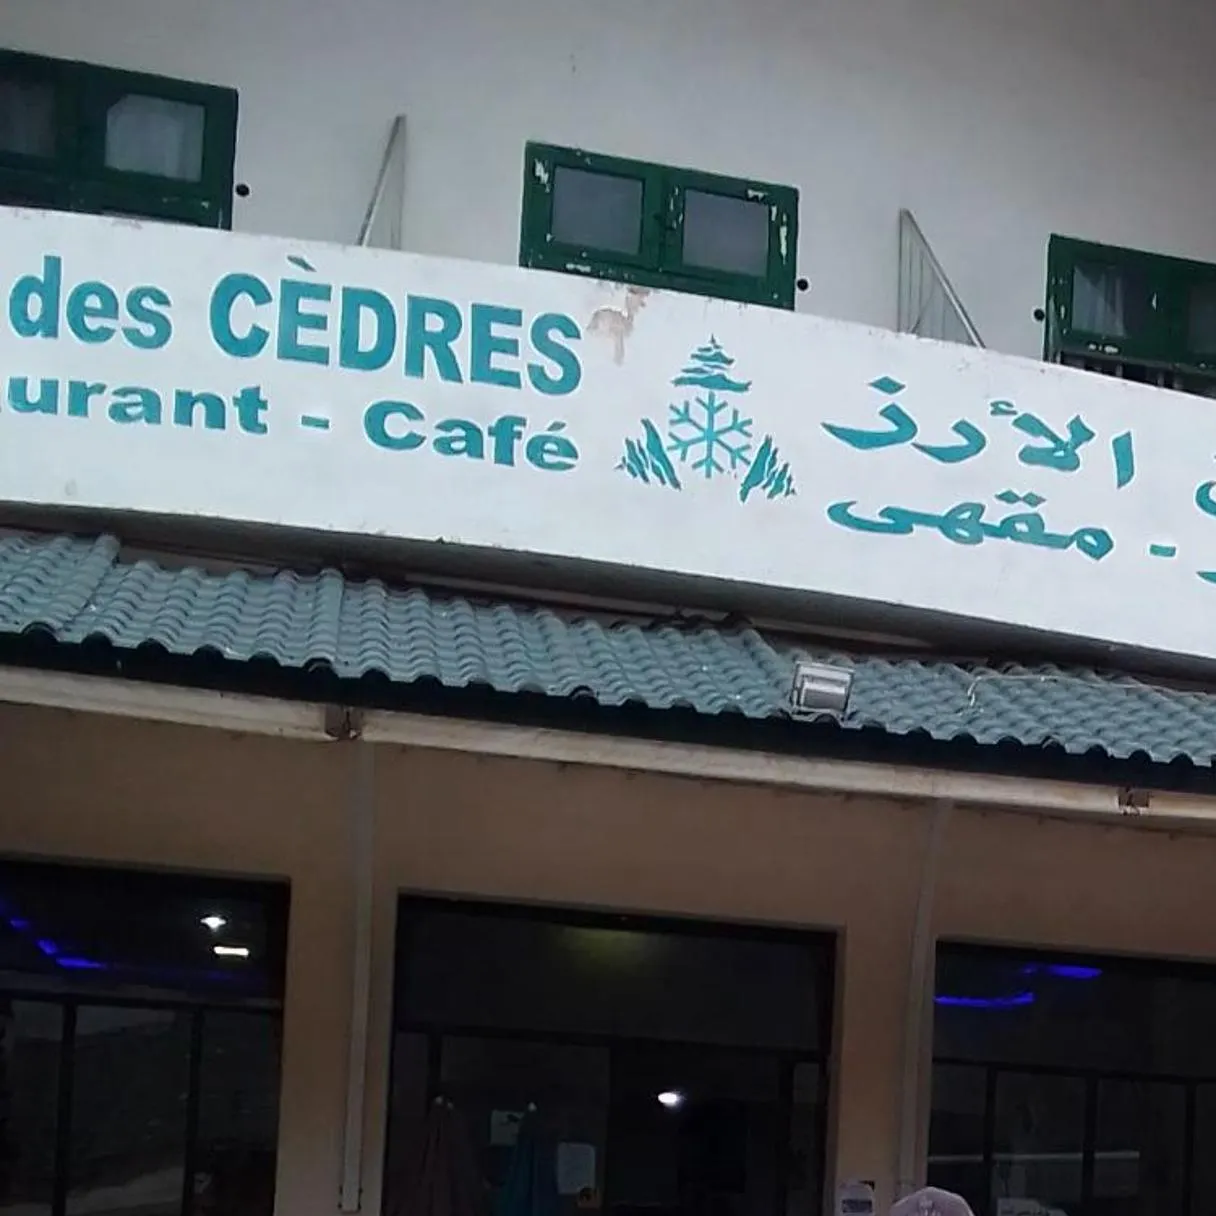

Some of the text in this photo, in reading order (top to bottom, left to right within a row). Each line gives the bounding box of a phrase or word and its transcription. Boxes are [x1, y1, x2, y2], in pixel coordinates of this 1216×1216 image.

[8, 254, 583, 396] des CÈDRES
[0, 376, 269, 435] urant
[363, 400, 580, 472] Café
[819, 374, 1135, 488] الأرز
[826, 488, 1114, 561] مقهى
